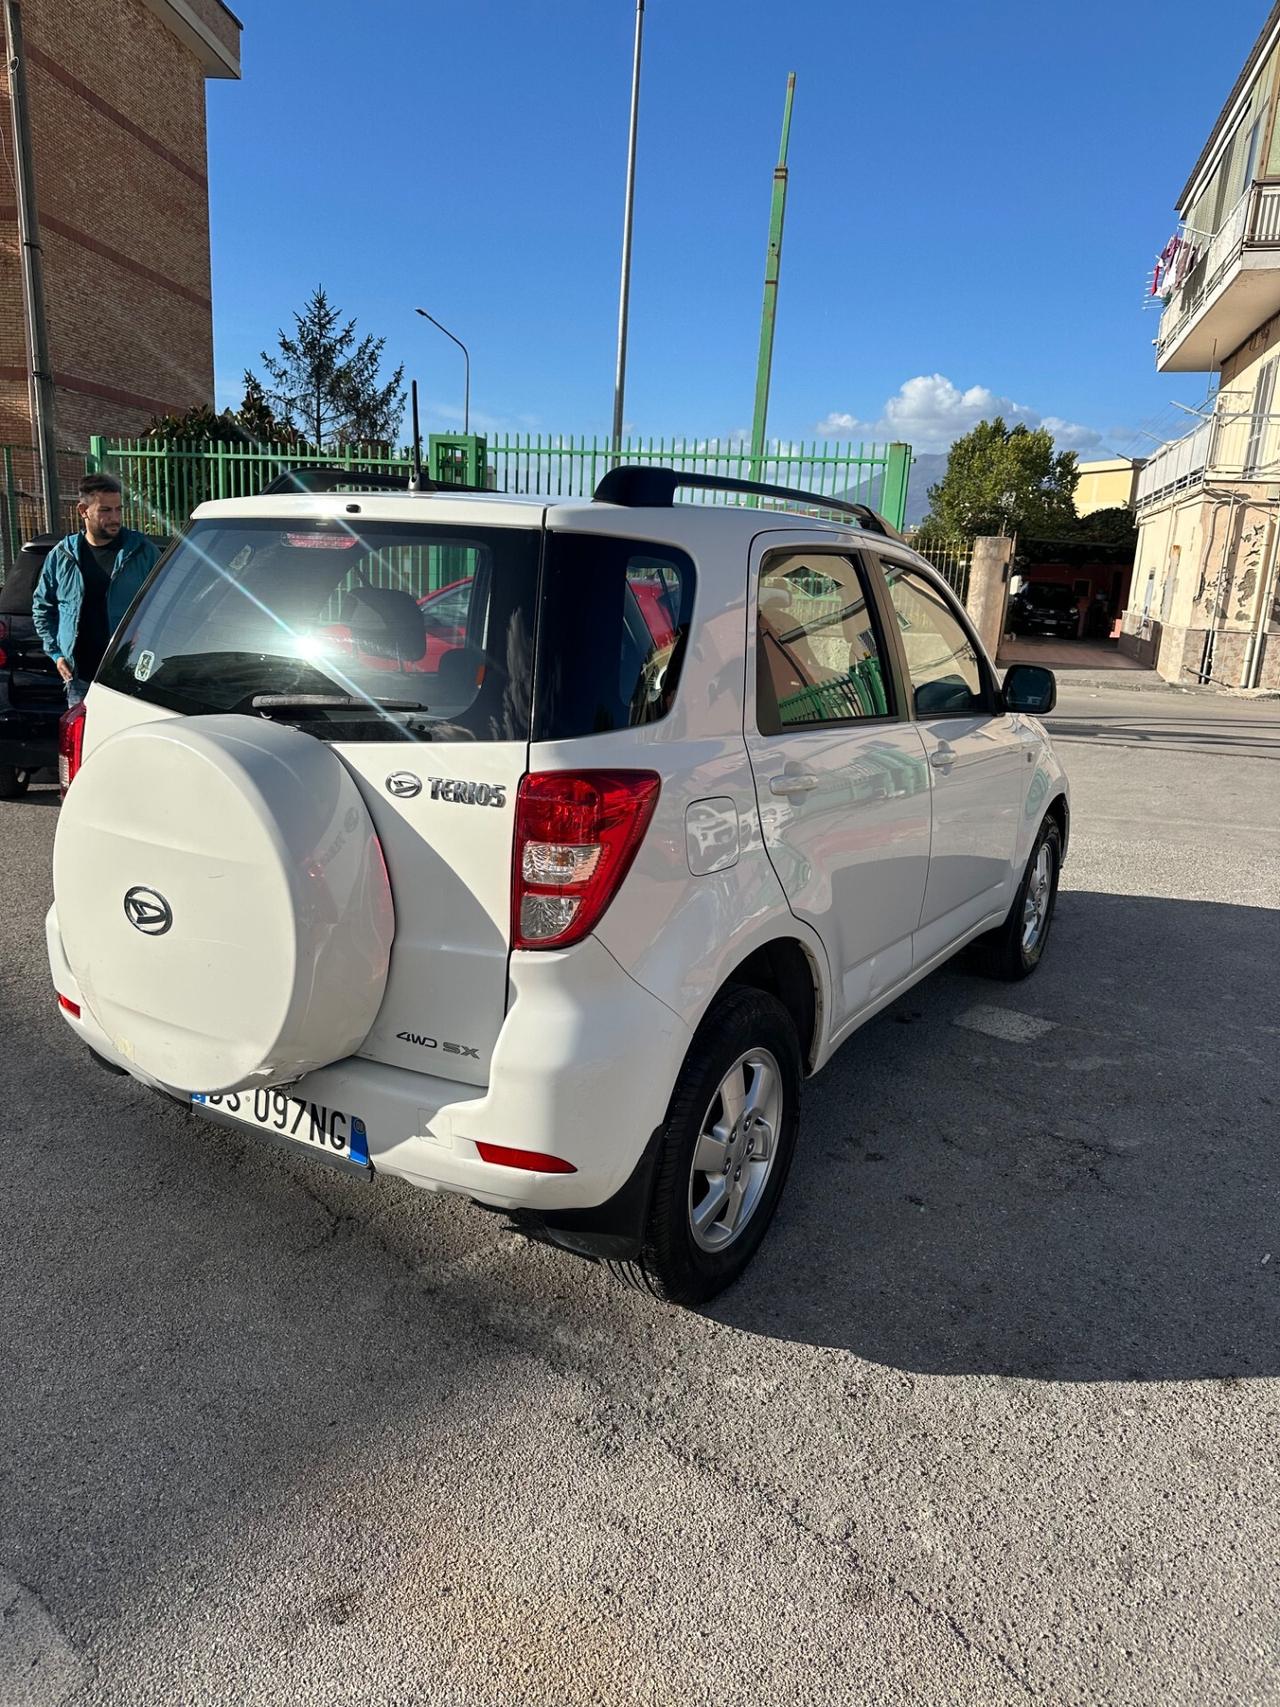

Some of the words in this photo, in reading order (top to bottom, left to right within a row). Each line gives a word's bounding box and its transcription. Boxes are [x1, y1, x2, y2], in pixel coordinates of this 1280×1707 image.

[427, 776, 506, 808] TERIOS
[396, 1031, 438, 1049] 4WD
[442, 1041, 480, 1060] SX
[209, 1092, 241, 1112] S
[254, 1088, 346, 1151] 097NG
